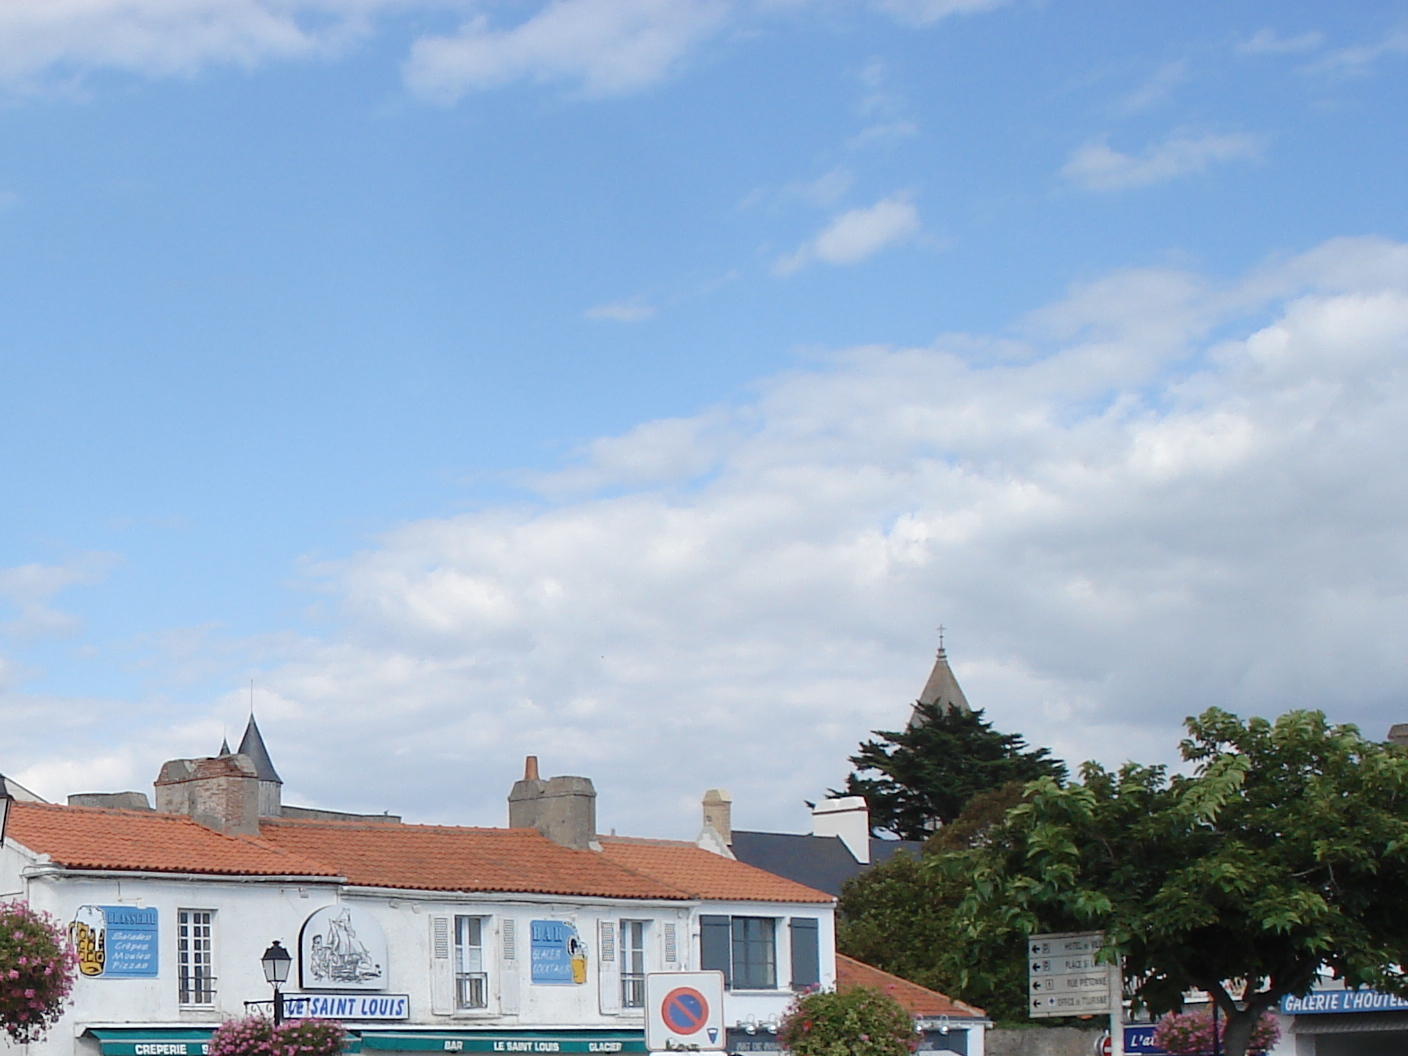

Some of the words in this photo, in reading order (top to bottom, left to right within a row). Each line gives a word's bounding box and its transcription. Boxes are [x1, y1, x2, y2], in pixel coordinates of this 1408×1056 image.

[106, 912, 156, 925] BRASSERIE
[532, 925, 562, 942] BAR
[310, 998, 357, 1016] SAINT
[361, 999, 405, 1016] LOUIS
[1285, 994, 1339, 1011] GALERIE
[135, 1044, 187, 1055] CREPERIE
[444, 1041, 464, 1051] BAR
[494, 1042, 504, 1051] LE
[507, 1042, 533, 1052] SAINT
[535, 1042, 560, 1052] LOUIS
[588, 1042, 622, 1052] GLACIER
